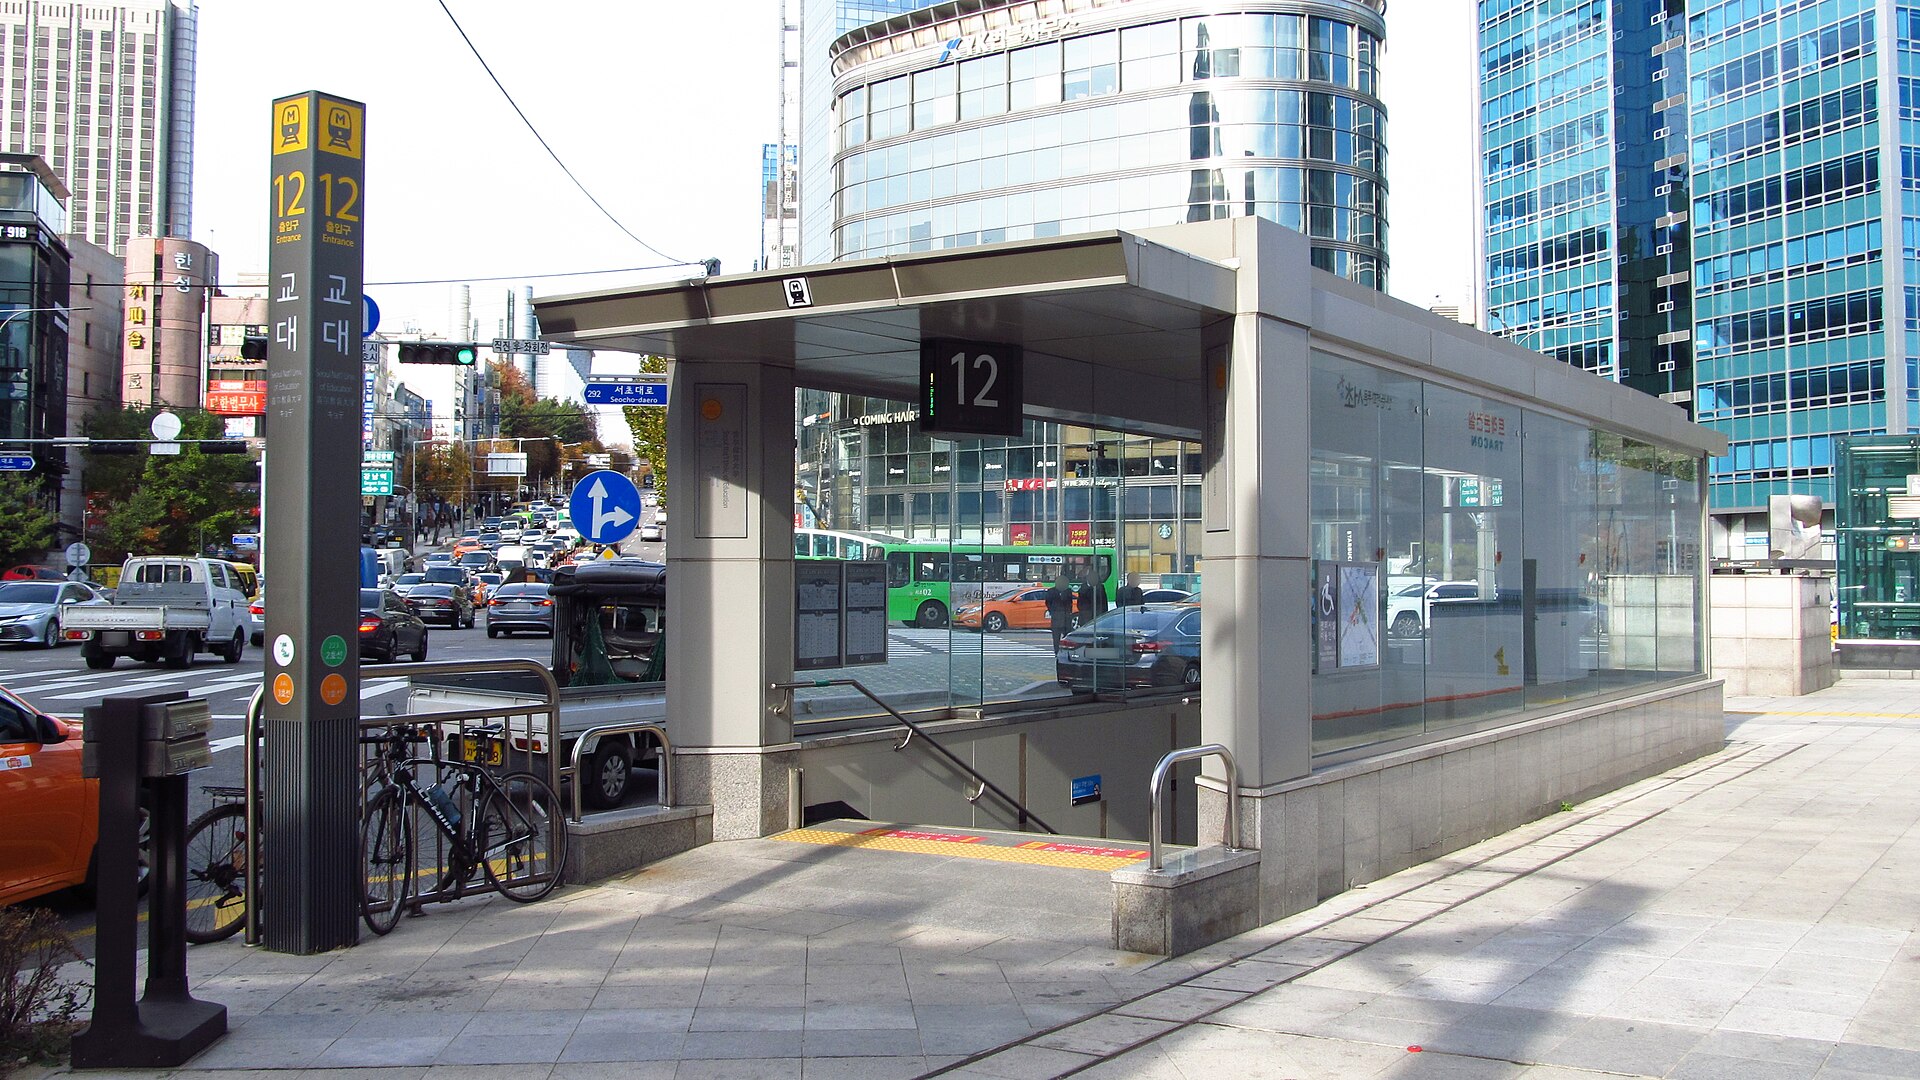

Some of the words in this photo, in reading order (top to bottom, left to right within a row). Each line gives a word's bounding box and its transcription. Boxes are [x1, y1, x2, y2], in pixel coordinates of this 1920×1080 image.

[274, 170, 306, 218] 12
[319, 173, 359, 222] 12
[278, 220, 300, 233] 출입구
[325, 220, 352, 235] 출입구
[276, 234, 302, 244] Entrance
[322, 235, 355, 248] Entrance
[174, 252, 193, 293] 한성
[277, 272, 300, 352] 교대
[323, 274, 352, 356] 교대
[494, 340, 510, 352] 직진
[523, 342, 549, 354] 좌회전
[950, 352, 999, 408] 12
[587, 389, 601, 398] 292
[614, 385, 655, 395] 서초대로
[610, 396, 658, 404] Seocho-daero
[859, 413, 893, 426] COMING
[894, 410, 916, 423] HAIR
